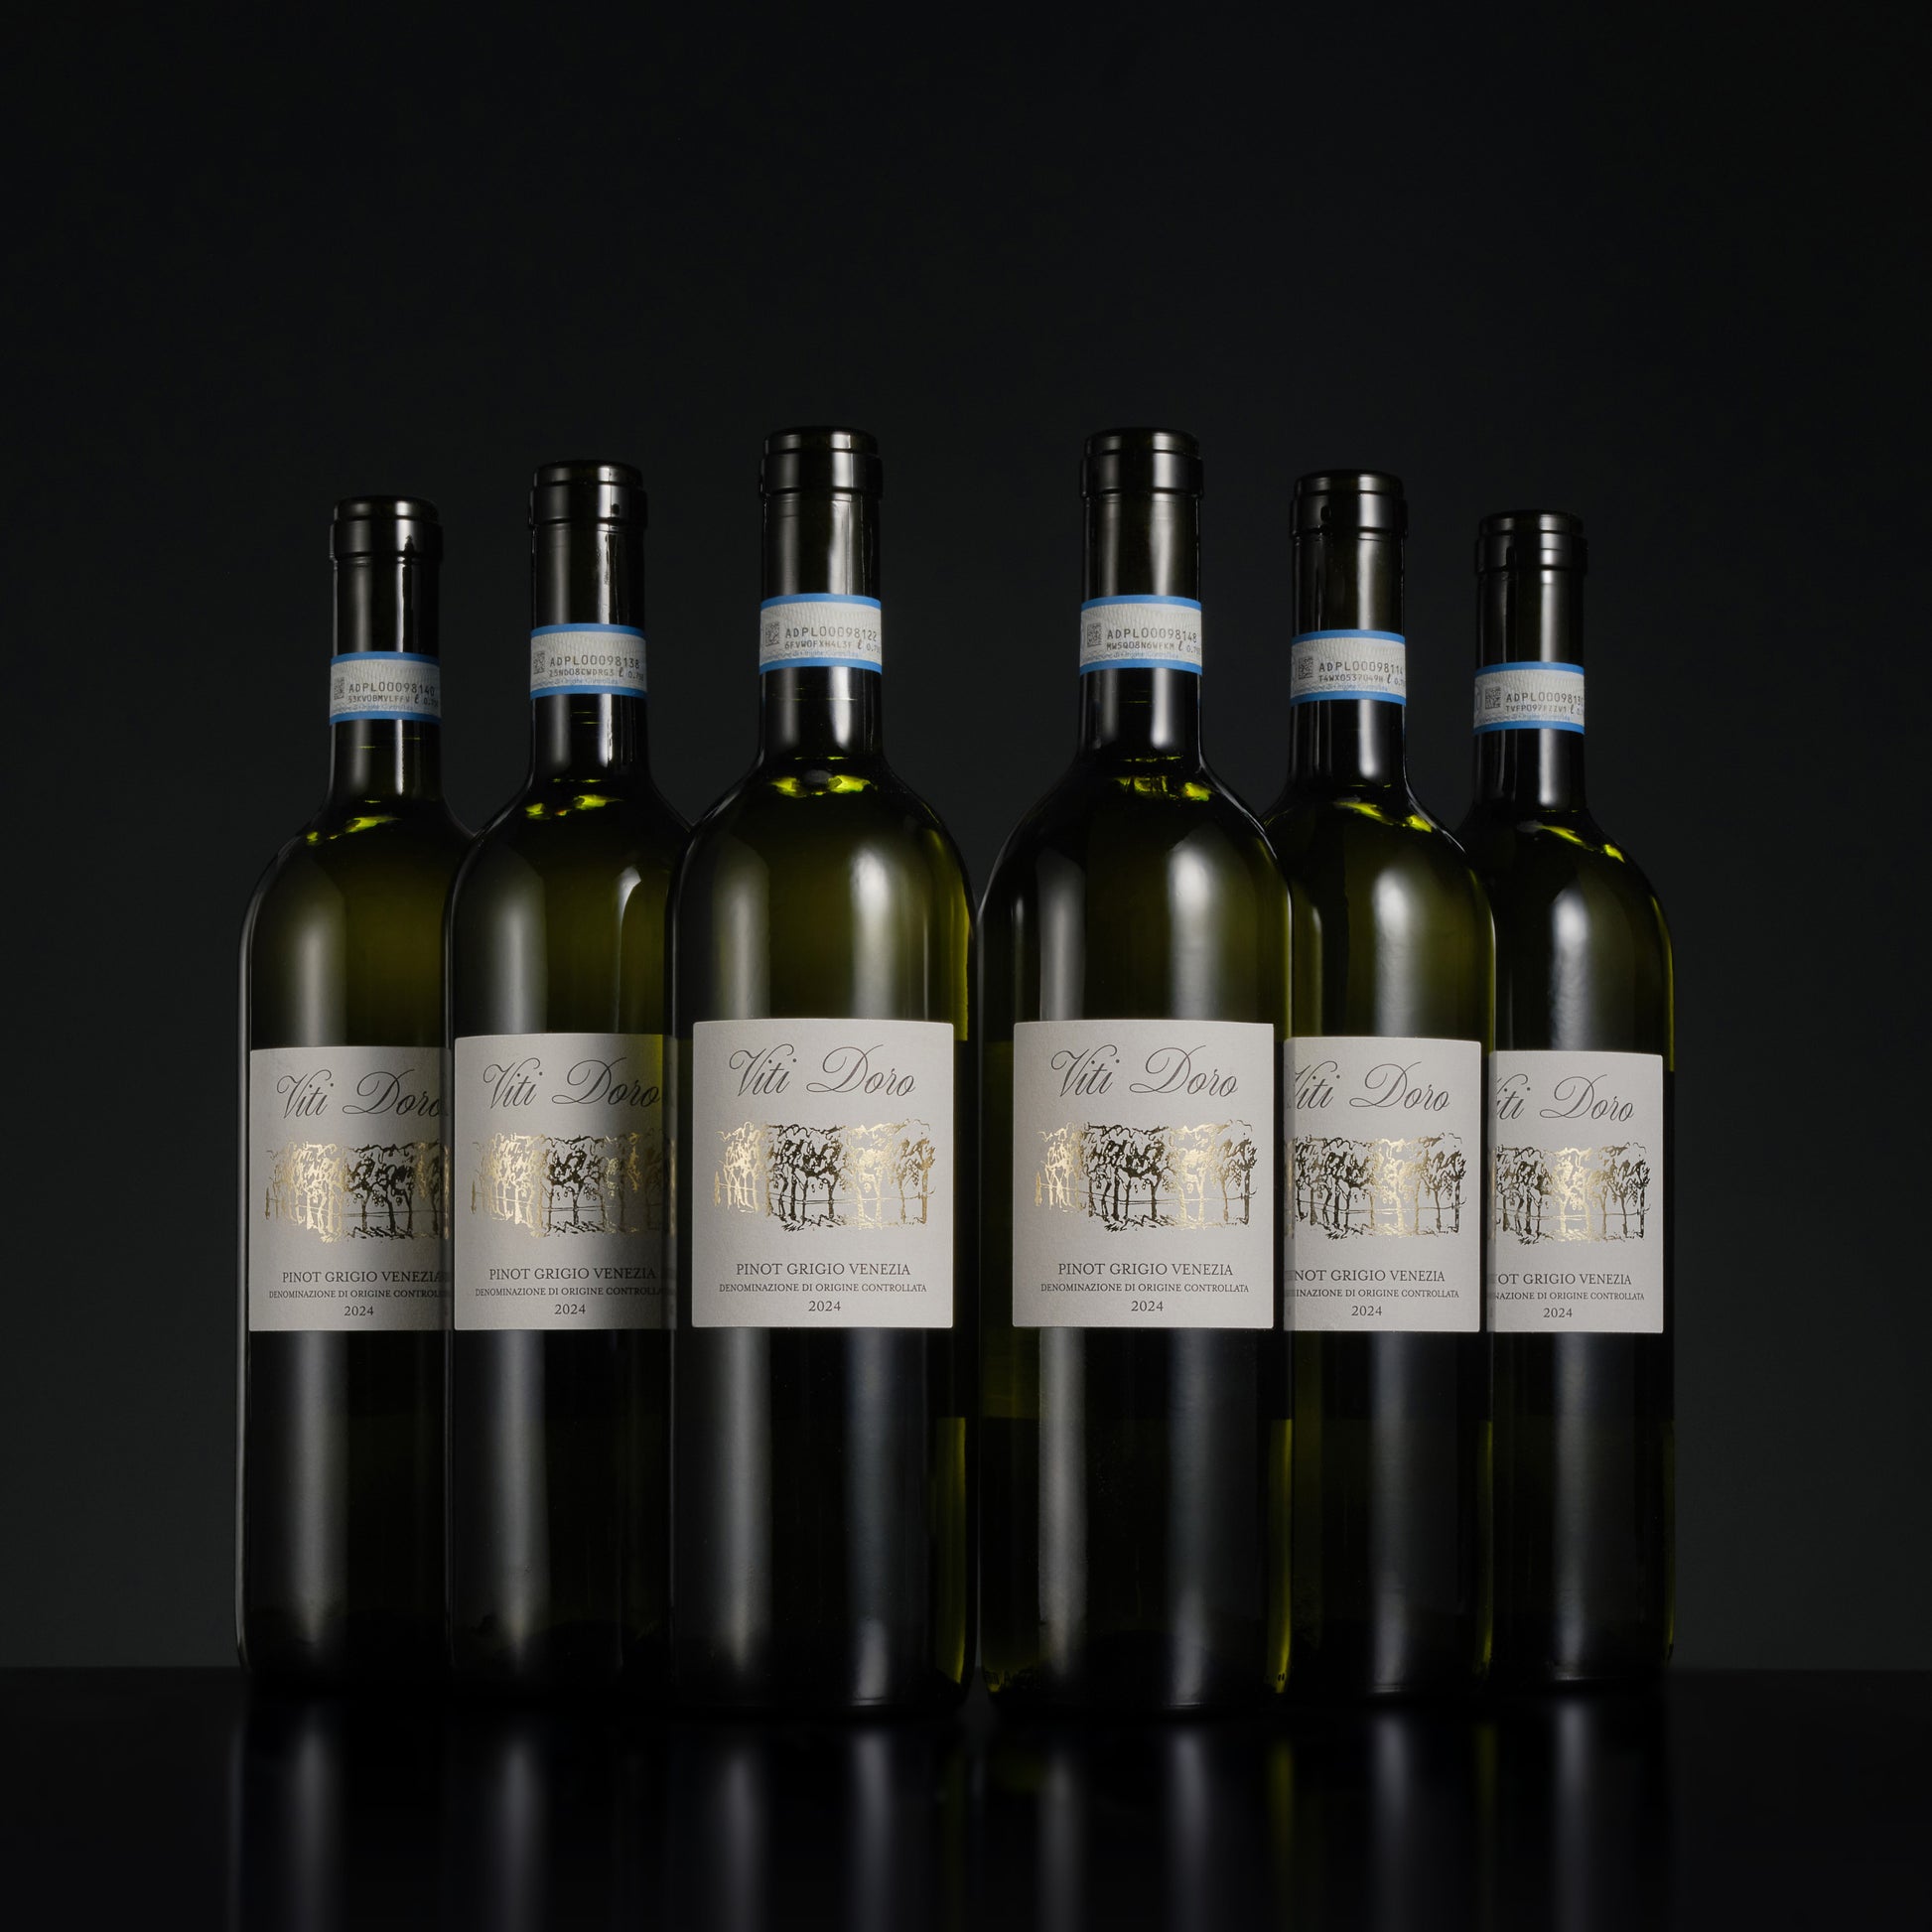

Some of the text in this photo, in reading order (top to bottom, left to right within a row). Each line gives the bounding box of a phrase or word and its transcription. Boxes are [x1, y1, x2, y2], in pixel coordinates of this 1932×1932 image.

[1107, 627, 1197, 643] ADPL00098148
[729, 1043, 916, 1097] Viti Doro
[1050, 1043, 1238, 1097] Viti Doro
[483, 1056, 661, 1109] Viti Doro
[1348, 1060, 1450, 1112] Doro
[276, 1069, 334, 1119] Viti
[1539, 1073, 1634, 1122] Doro
[489, 1268, 657, 1280] PINOT GRIGIO VENEZIA
[736, 1263, 911, 1276] PINOT GRIGIO VENEZIA
[1058, 1263, 1234, 1276] PINOT GRIGIO VENEZIA
[282, 1272, 321, 1283] PINOT
[325, 1271, 378, 1283] GRIGIO
[1295, 1270, 1446, 1282] NOT GRIGIO VENEZIA
[1523, 1273, 1577, 1285] GRIGIO
[1579, 1273, 1632, 1285] VENEZIA
[475, 1288, 546, 1297] DENOMINAZIONE
[561, 1287, 604, 1296] ORIGINE
[719, 1283, 927, 1293] DENOMINAZIONE DI ORIGINE CONTROLLATA
[1040, 1283, 1249, 1293] DENOMINAZIONE DI ORIGINE CONTROLLATA
[1345, 1289, 1355, 1298] DI
[1358, 1289, 1399, 1298] ORIGINE
[1401, 1290, 1459, 1299] CONTROLLATA
[338, 1290, 348, 1299] DI
[350, 1290, 391, 1299] ORIGINE
[393, 1290, 441, 1299] CONTROL
[1537, 1292, 1547, 1301] DI
[1549, 1292, 1588, 1301] ORIGINE
[1589, 1292, 1645, 1301] CONTROLLATA
[345, 1306, 374, 1316] 2024
[554, 1304, 586, 1315] 2024
[808, 1300, 842, 1311] 2024
[1131, 1301, 1164, 1311] 2024
[1351, 1306, 1382, 1316] 2024
[1543, 1308, 1573, 1318] 2024
